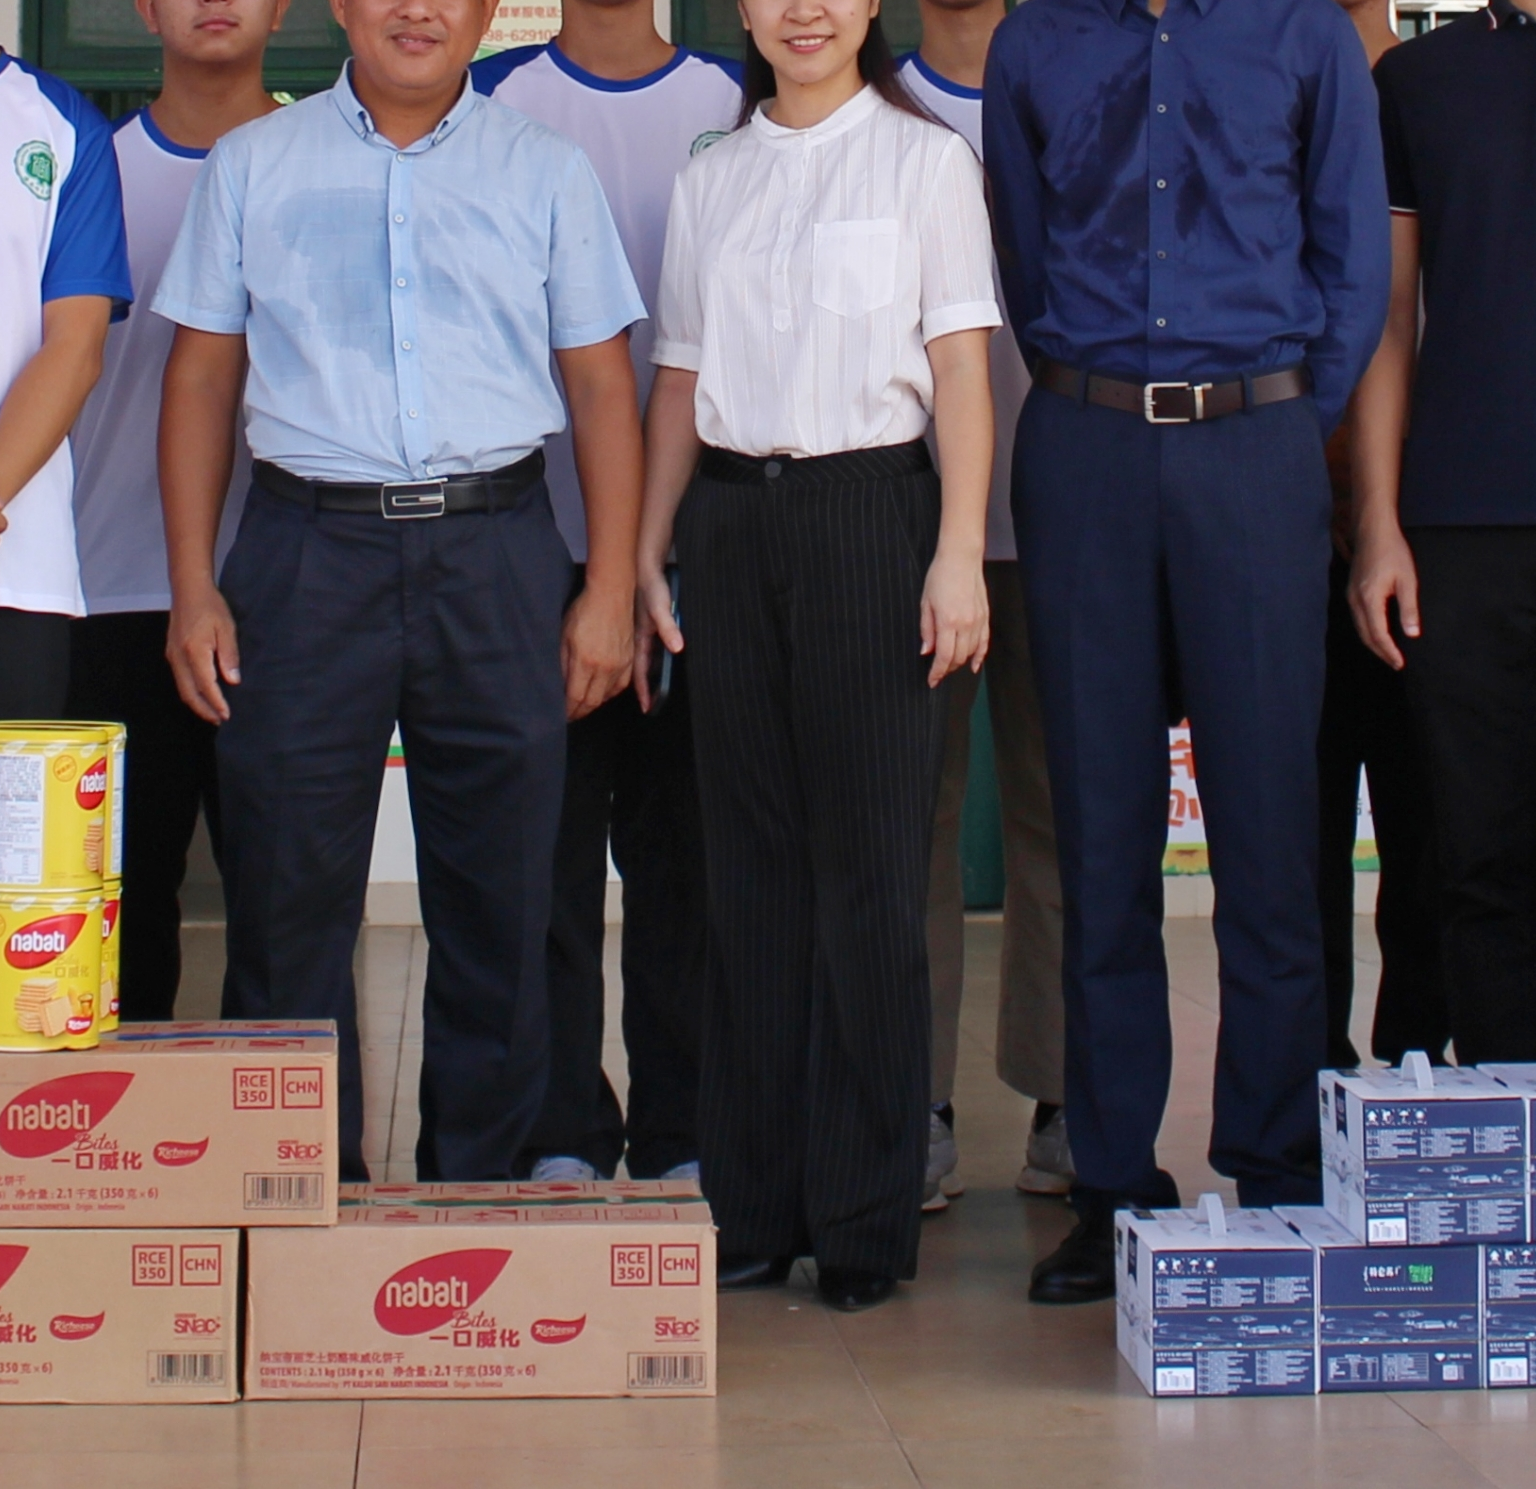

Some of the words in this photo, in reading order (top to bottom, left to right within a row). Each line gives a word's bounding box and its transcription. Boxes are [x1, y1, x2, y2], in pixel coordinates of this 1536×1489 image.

[11, 932, 65, 953] nabati
[240, 1075, 267, 1088] RCE
[286, 1081, 318, 1094] CHN
[240, 1091, 267, 1102] 350
[7, 1099, 90, 1130] nabati
[51, 1151, 142, 1170] 一口威化
[139, 1252, 166, 1265] RCE
[185, 1258, 217, 1271] CHN
[618, 1252, 645, 1265] RCE
[664, 1258, 696, 1271] CHN
[139, 1267, 166, 1280] 350
[618, 1267, 645, 1280] 350
[385, 1277, 468, 1308] nabati
[429, 1330, 520, 1348] 一口威化
